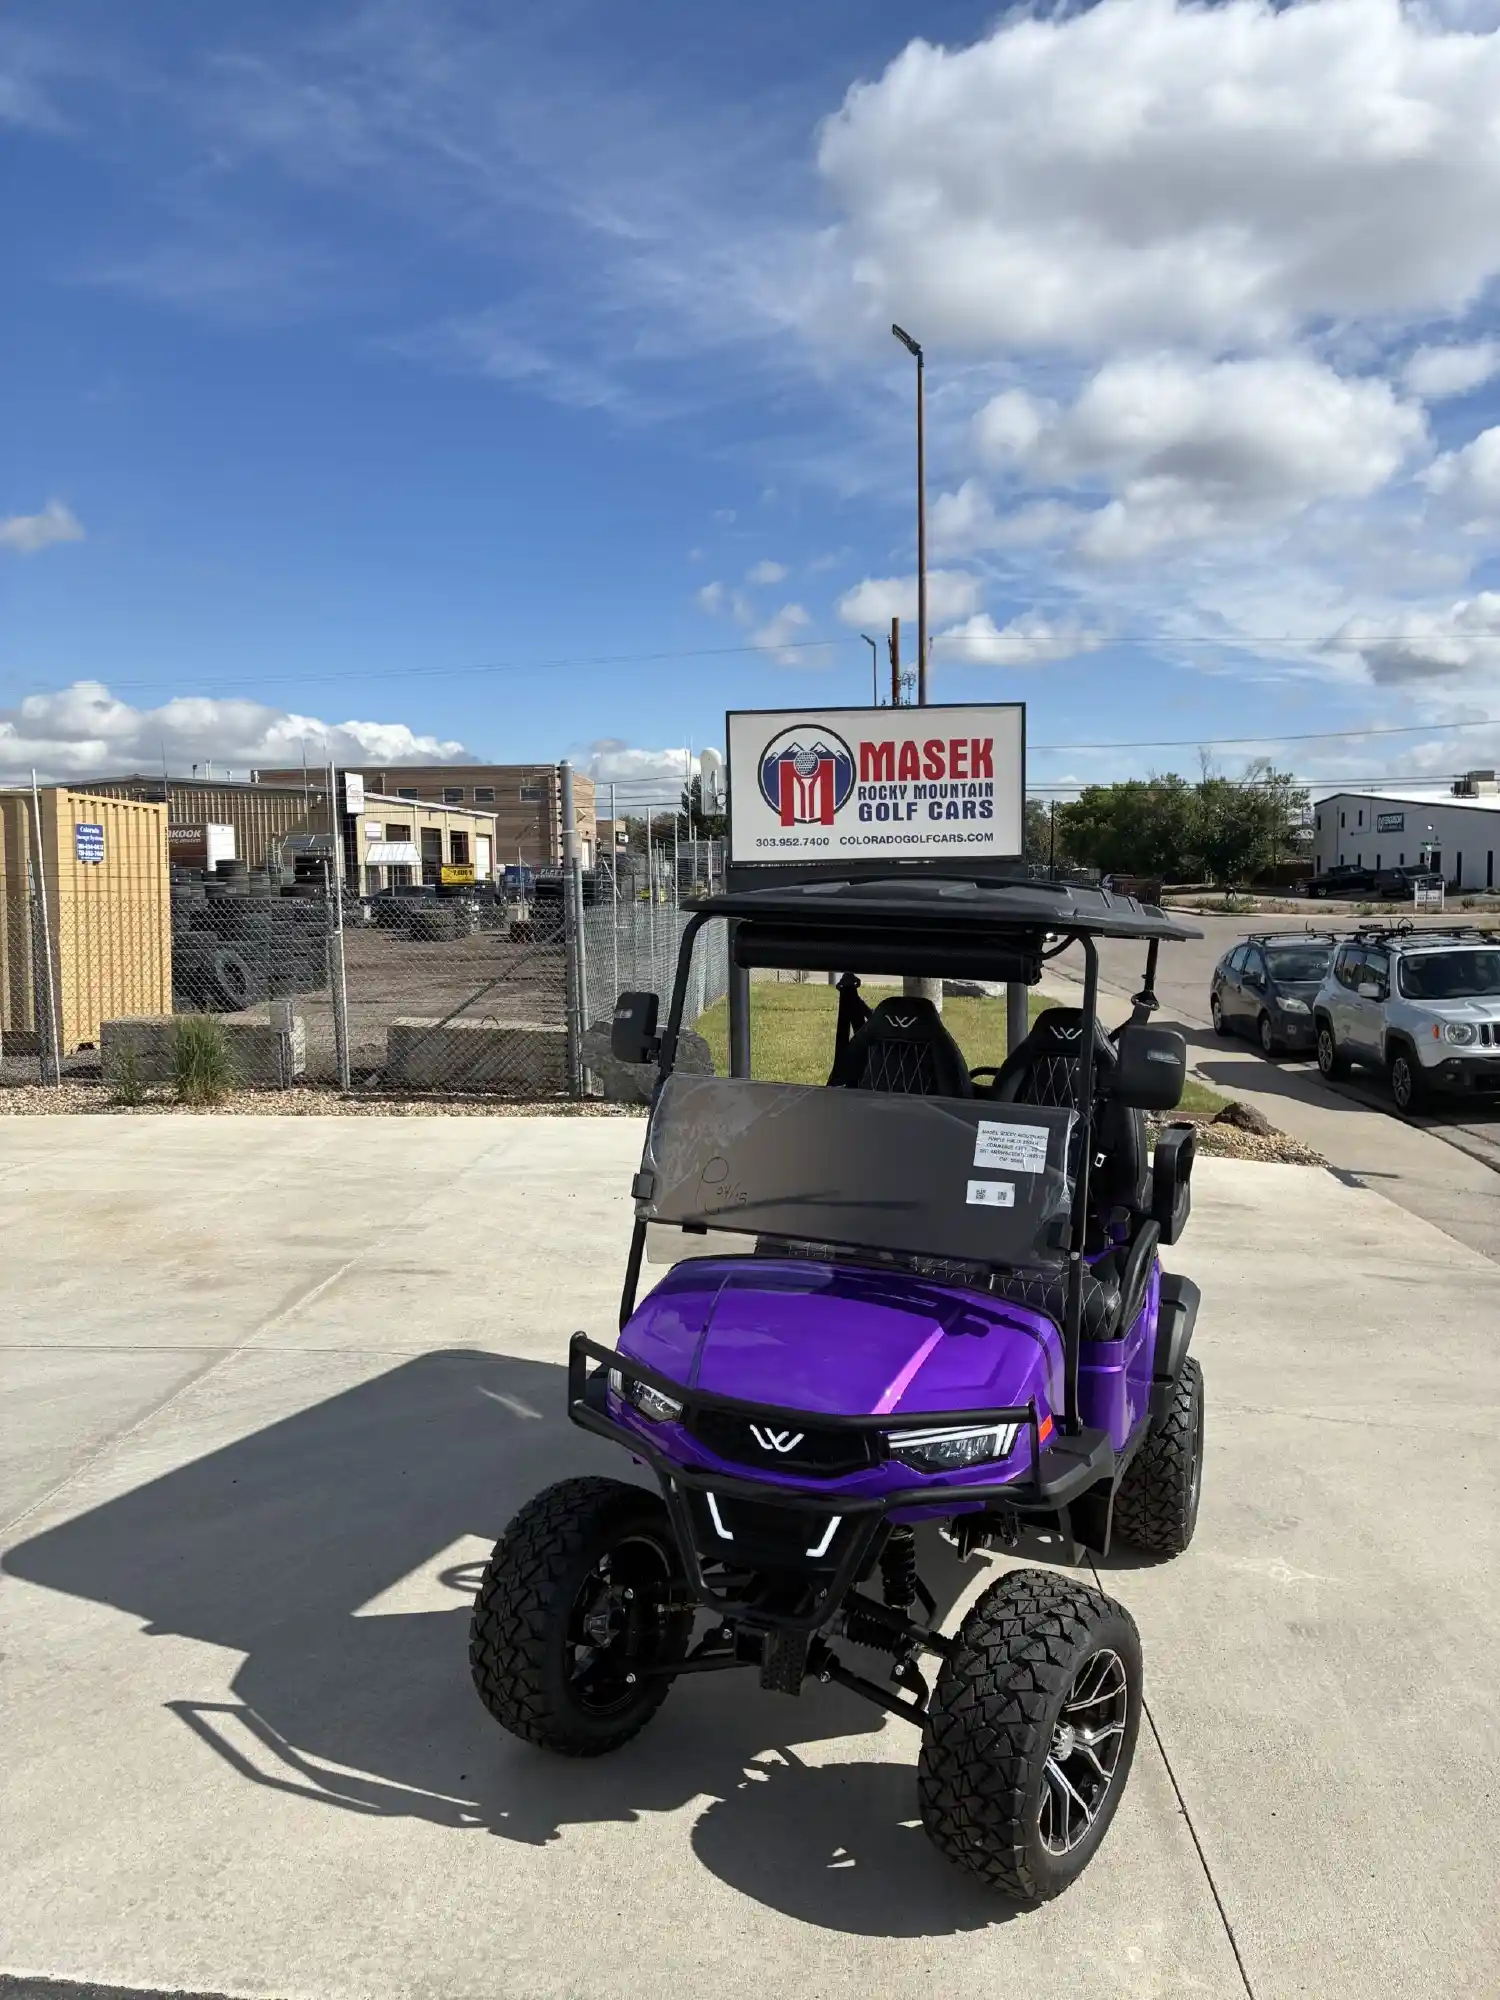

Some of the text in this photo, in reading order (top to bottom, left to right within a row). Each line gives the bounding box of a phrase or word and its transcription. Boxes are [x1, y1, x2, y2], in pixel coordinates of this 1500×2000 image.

[860, 738, 993, 782] MASEK
[858, 782, 993, 800] ROCKY MOUNTAIN
[859, 799, 993, 822] GOLF CARS
[756, 832, 994, 847] 303.952.7400 COLORADOGOLFCARS.COM
